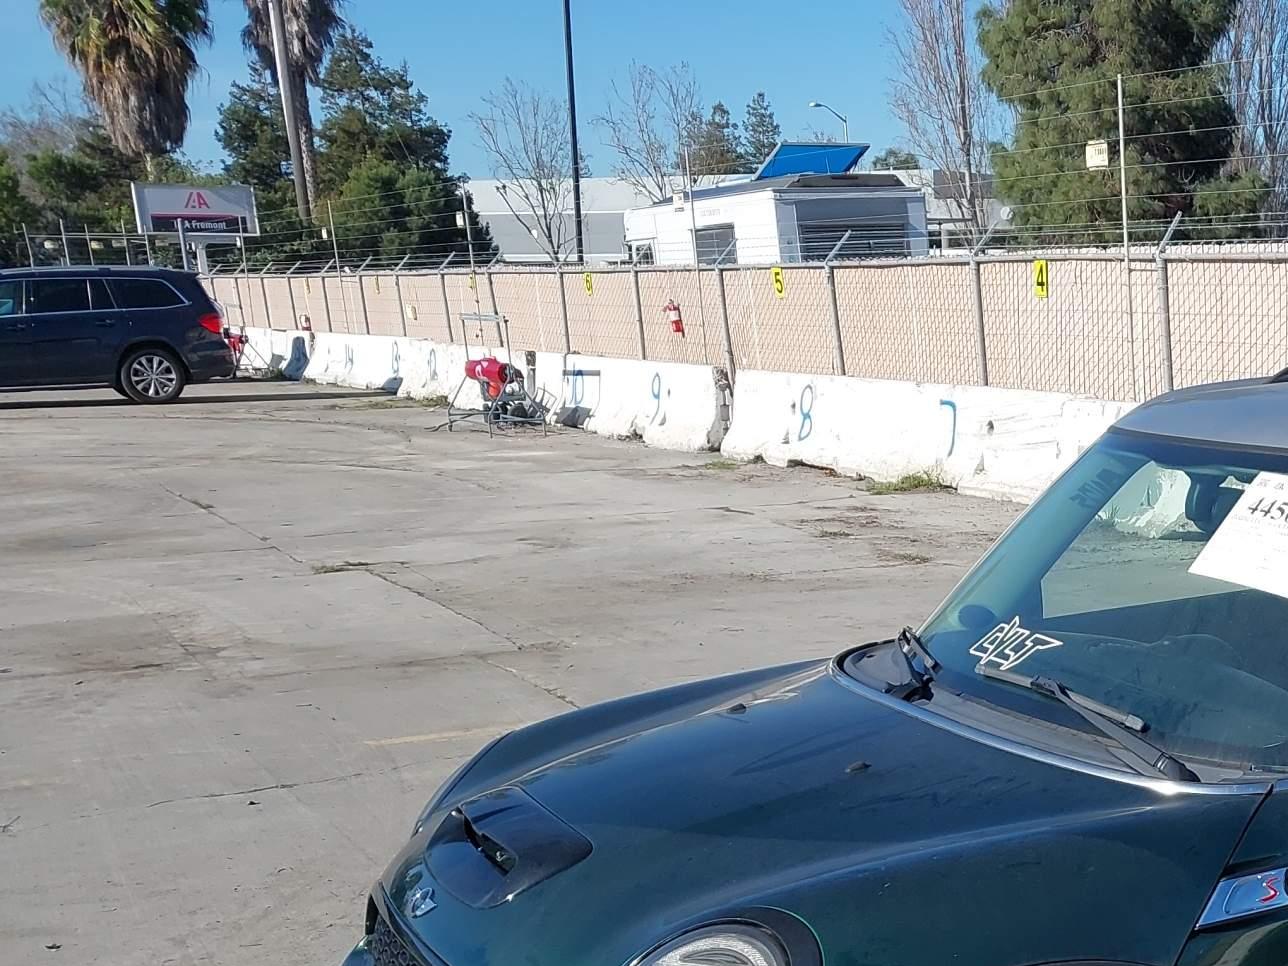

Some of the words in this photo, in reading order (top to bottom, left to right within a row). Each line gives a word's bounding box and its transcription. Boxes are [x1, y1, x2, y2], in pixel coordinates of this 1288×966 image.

[193, 219, 226, 230] Fremont
[585, 274, 592, 292] 6
[774, 271, 784, 294] 5
[1036, 263, 1046, 292] 4
[569, 362, 585, 405] 10
[651, 372, 661, 425] 9
[798, 383, 814, 442] 8
[939, 399, 957, 459] 7
[1256, 877, 1280, 904] S
